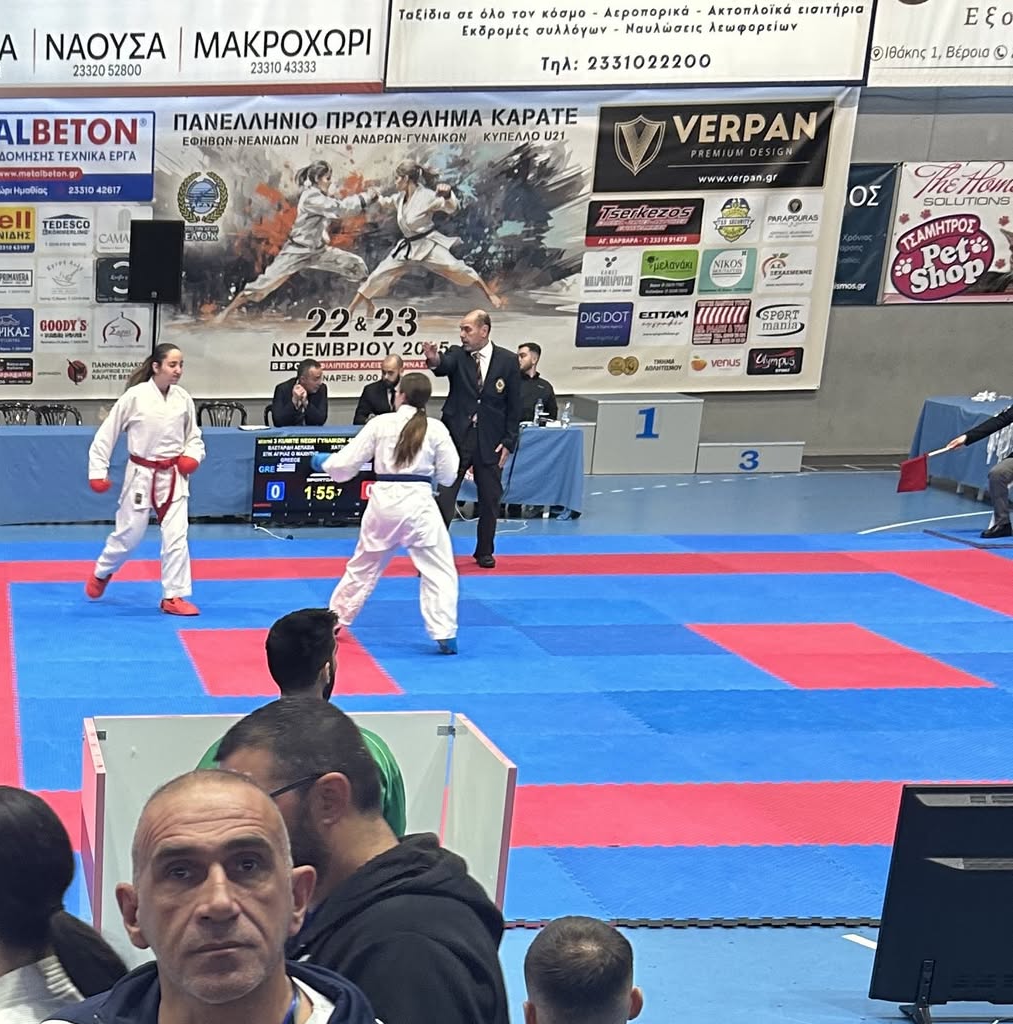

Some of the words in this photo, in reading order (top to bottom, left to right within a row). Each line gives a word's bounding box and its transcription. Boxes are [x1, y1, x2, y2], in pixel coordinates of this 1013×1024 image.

[398, 9, 451, 21] Ταξίδια
[457, 11, 474, 20] σε
[480, 8, 506, 20] όλο
[512, 9, 536, 19] τον
[542, 8, 586, 22] κόσμο
[604, 6, 690, 20] Αεροπορικά
[708, 3, 792, 17] Ακτοπλοϊκά
[798, 3, 864, 18] εισιτήρια
[461, 24, 529, 39] Εκδρομές
[536, 24, 607, 39] συλλόγων
[625, 22, 702, 36] Ναυλώσεις
[709, 20, 798, 36] λεωφορείων
[45, 32, 167, 61] ΝΑΟΥΣΑ
[193, 28, 373, 59] ΜΑΚΡΟΧΩΡΙ
[885, 46, 926, 61] Ιθάκης
[946, 44, 990, 62] Βέροια
[73, 64, 106, 77] 23320
[107, 64, 142, 77] 52800
[250, 62, 282, 75] 23310
[284, 61, 317, 74] 43333
[541, 56, 579, 75] Τηλ:
[587, 53, 711, 72] 2331022200
[174, 111, 319, 131] ΠΑΝΕΛΛΗΝΙΟ
[326, 109, 483, 129] ΠΡΩΤΑΘΛΗΜΑ
[491, 107, 578, 126] ΚΑΡΑΤΕ
[672, 111, 818, 144] VERPAN
[182, 134, 299, 147] ΕΦΗΒΩΝ-ΝΕΑΝΙΔΩΝ
[315, 134, 349, 145] ΝΕΩΝ
[352, 132, 467, 145] ΑΝΔΡΩΝ-ΓΥΝΑΙΚΩΝ
[483, 131, 540, 143] ΚΥΠΕΛΛΟ
[544, 130, 566, 142] U21
[58, 151, 106, 162] ΤΕΧΝΙΚΑ
[109, 151, 137, 162] ΕΡΓΑ
[691, 147, 744, 159] PREMIUM
[750, 147, 793, 157] DESIGN
[698, 173, 778, 185] www.verpan.gr
[914, 162, 963, 199] The
[15, 185, 48, 197] Ημαθίας
[68, 186, 94, 195] 23310
[96, 186, 121, 195] 42617
[923, 197, 1011, 206] SOLUTIONS
[600, 205, 695, 220] Tserkezos
[768, 214, 819, 222] PARAPOURAS
[42, 220, 90, 229] TEDESCO
[900, 218, 977, 251] ΤΣΑΜΗΤΡΟΣ
[920, 237, 971, 269] Pet
[653, 260, 693, 272] μελανάκι
[713, 259, 743, 269] NIKOS
[0, 272, 29, 281] PRIMAVERA
[910, 259, 985, 294] Shop
[305, 306, 351, 338] 22
[354, 316, 367, 332] &
[372, 306, 418, 338] 23
[762, 310, 800, 321] SPORT
[39, 319, 87, 332] GOODY'S
[761, 320, 799, 331] mania
[271, 341, 395, 357] ΝΟΕΜΒΡΙΟΥ
[402, 341, 449, 357] 205
[711, 358, 741, 368] venus
[322, 374, 356, 382] ΝΑΡΞΗ:
[636, 407, 659, 439] 1
[738, 450, 759, 471] 3
[258, 465, 275, 473] GRE
[271, 485, 280, 499] 0
